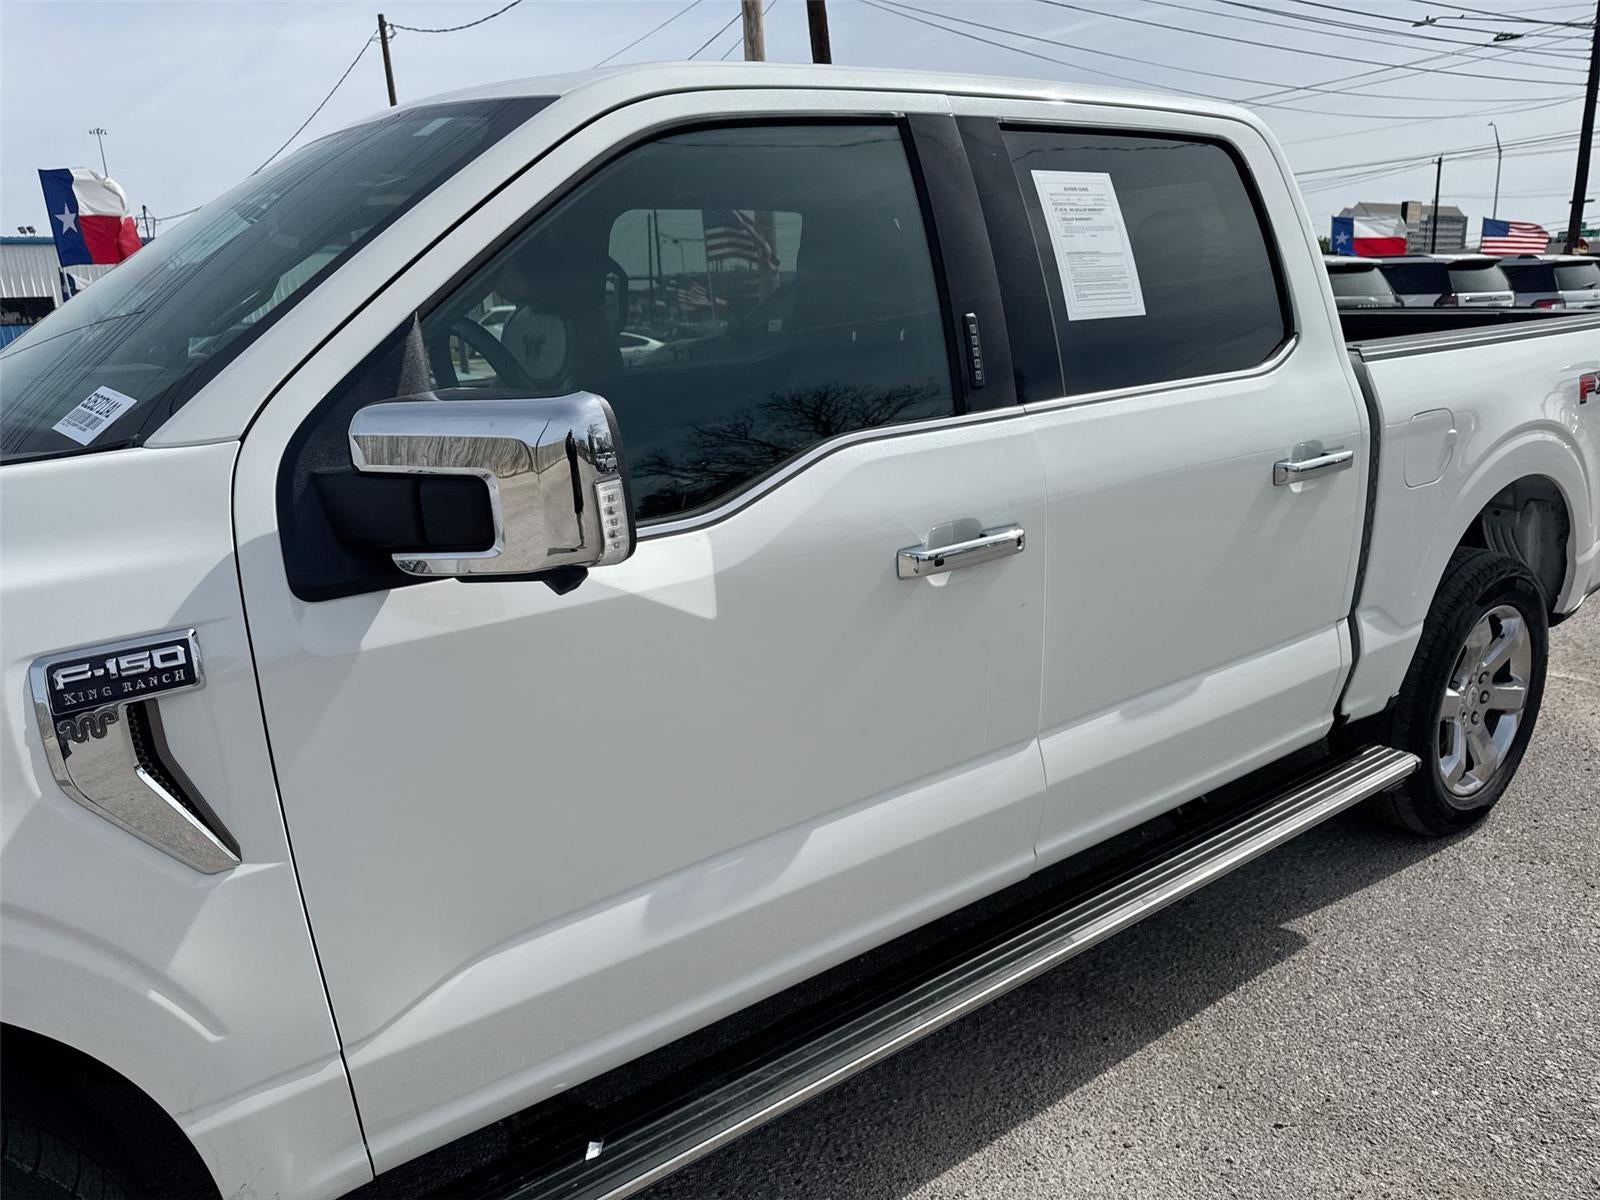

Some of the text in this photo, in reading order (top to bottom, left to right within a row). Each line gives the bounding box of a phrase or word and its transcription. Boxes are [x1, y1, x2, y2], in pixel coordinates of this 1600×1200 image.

[53, 645, 186, 690] F-150
[63, 669, 186, 705] KING RANCH
